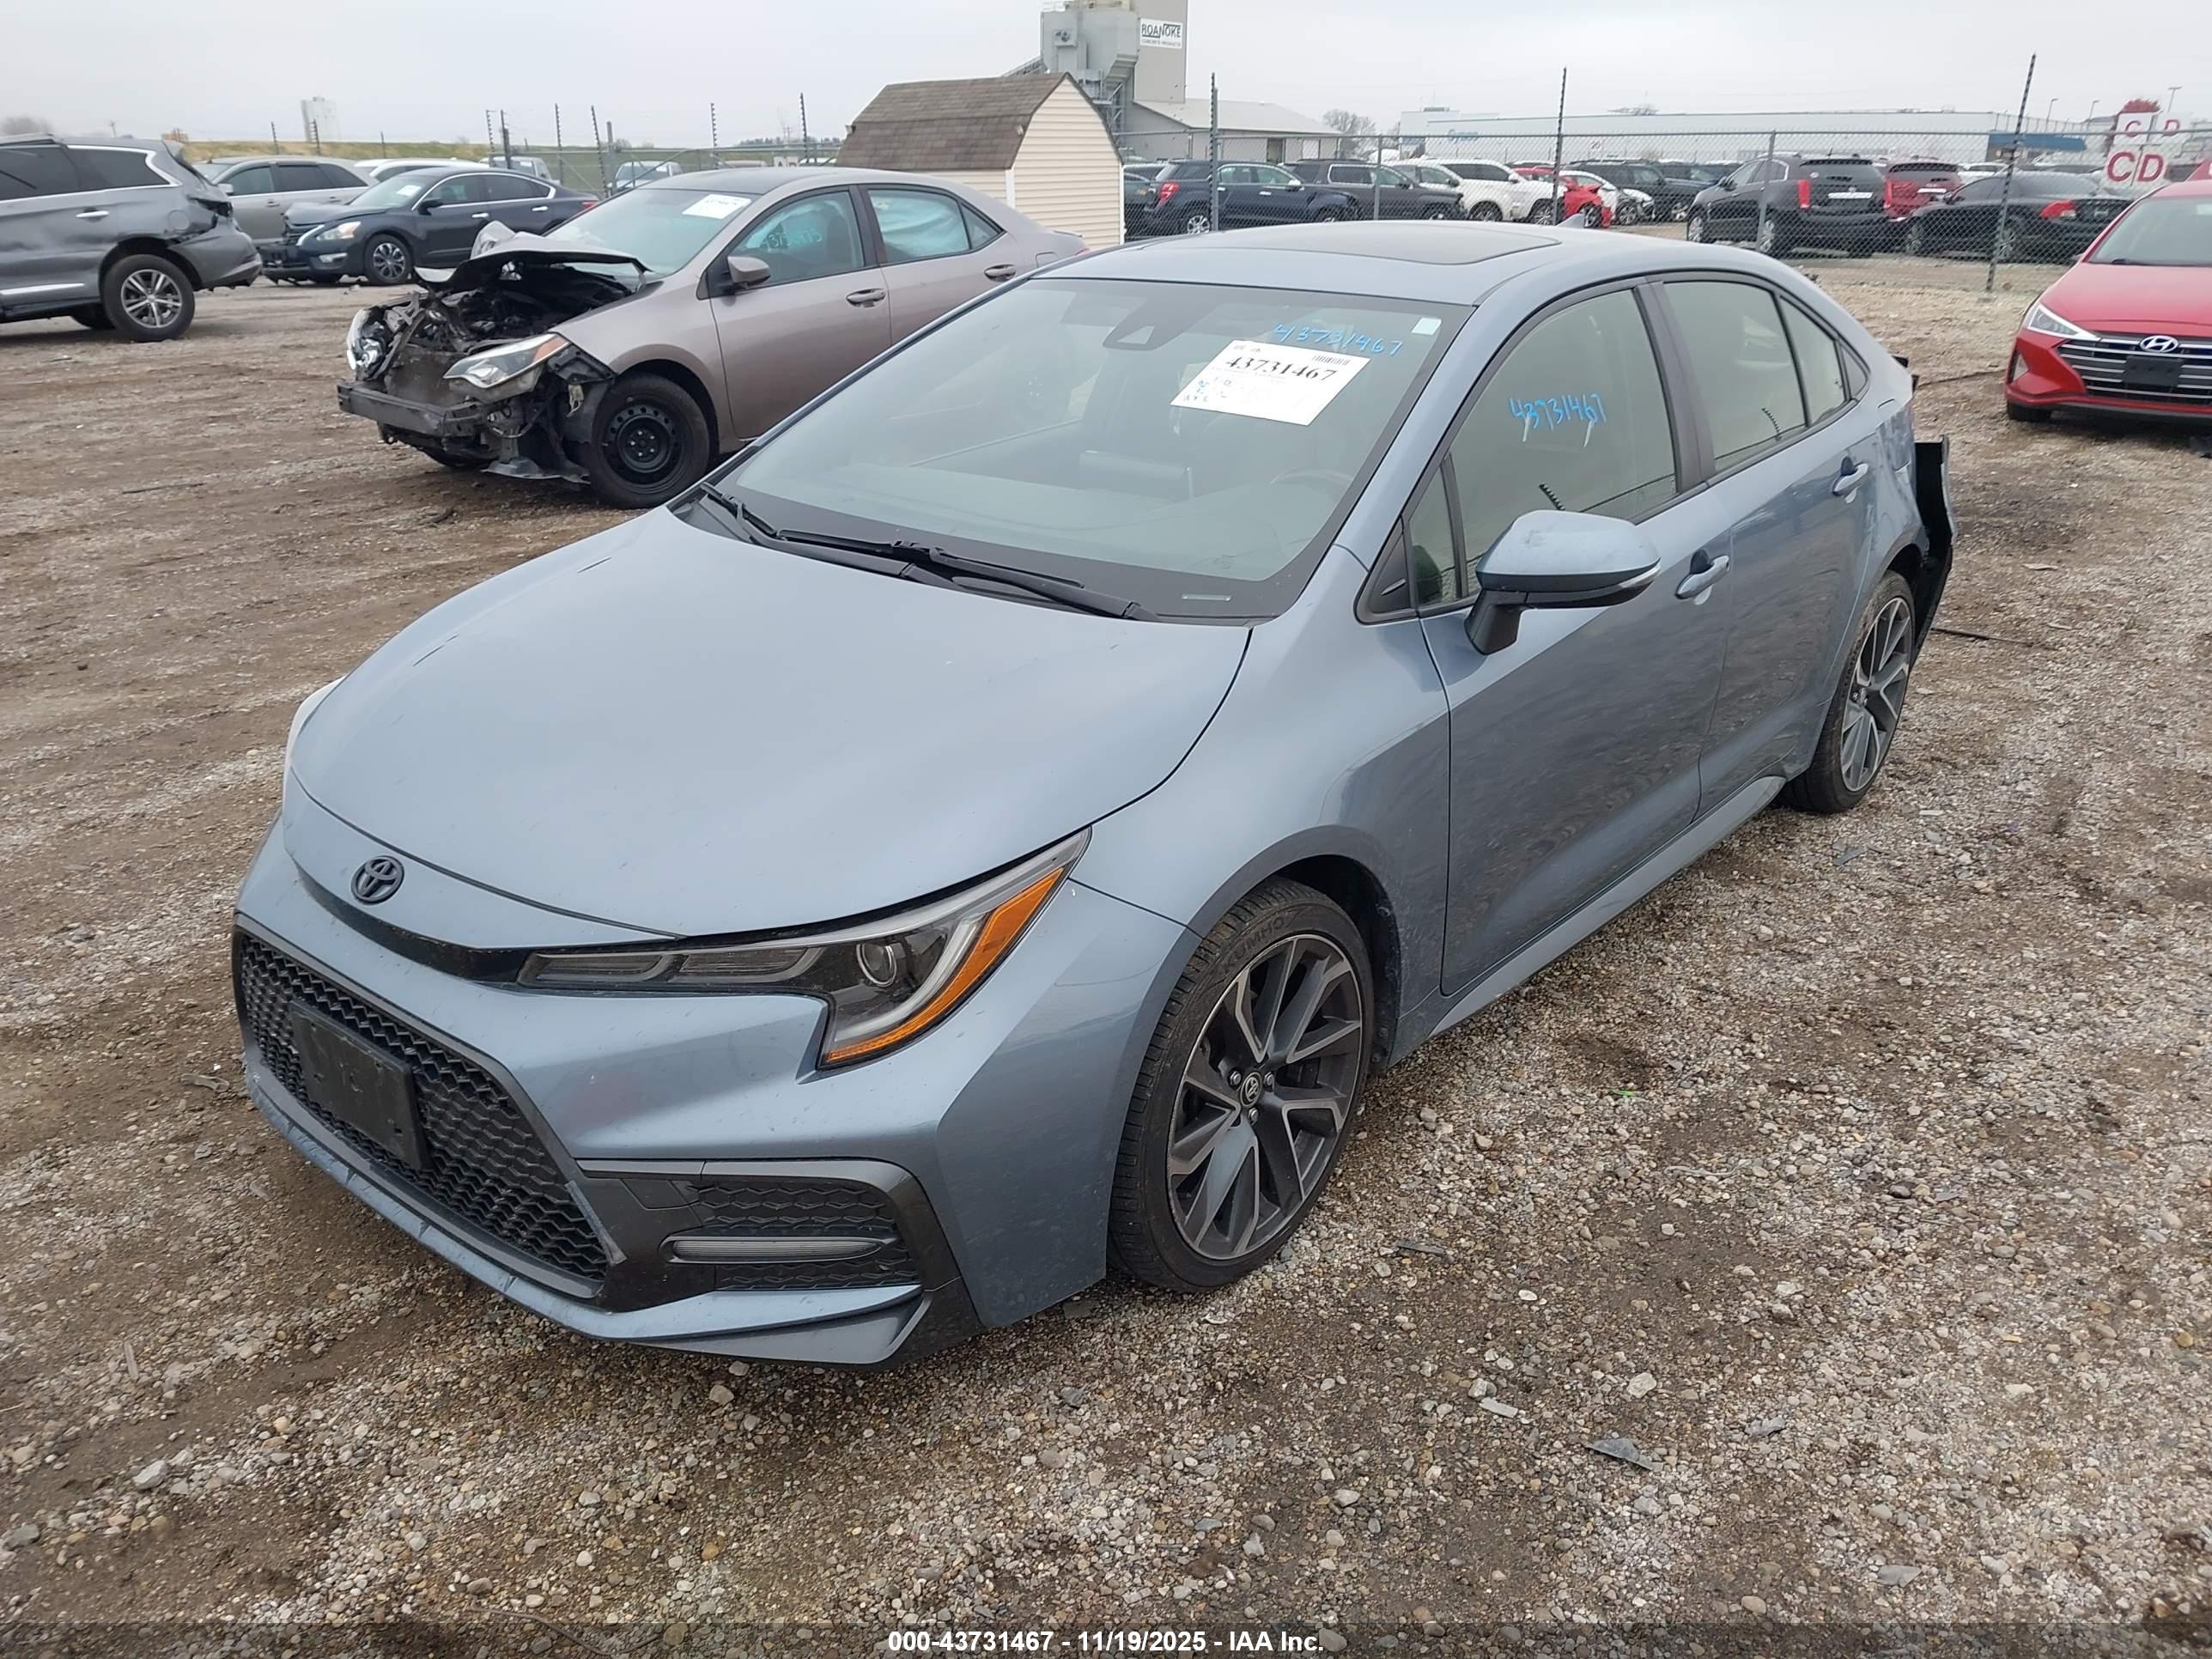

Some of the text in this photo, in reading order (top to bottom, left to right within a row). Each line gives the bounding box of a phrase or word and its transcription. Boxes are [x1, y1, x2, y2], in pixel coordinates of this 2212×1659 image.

[1141, 23, 1182, 38] ROANOKE
[1273, 323, 1403, 357] 43731467
[1225, 356, 1340, 381] 43731467
[1508, 392, 1607, 447] 43731467
[1223, 916, 1285, 973] KUMHO
